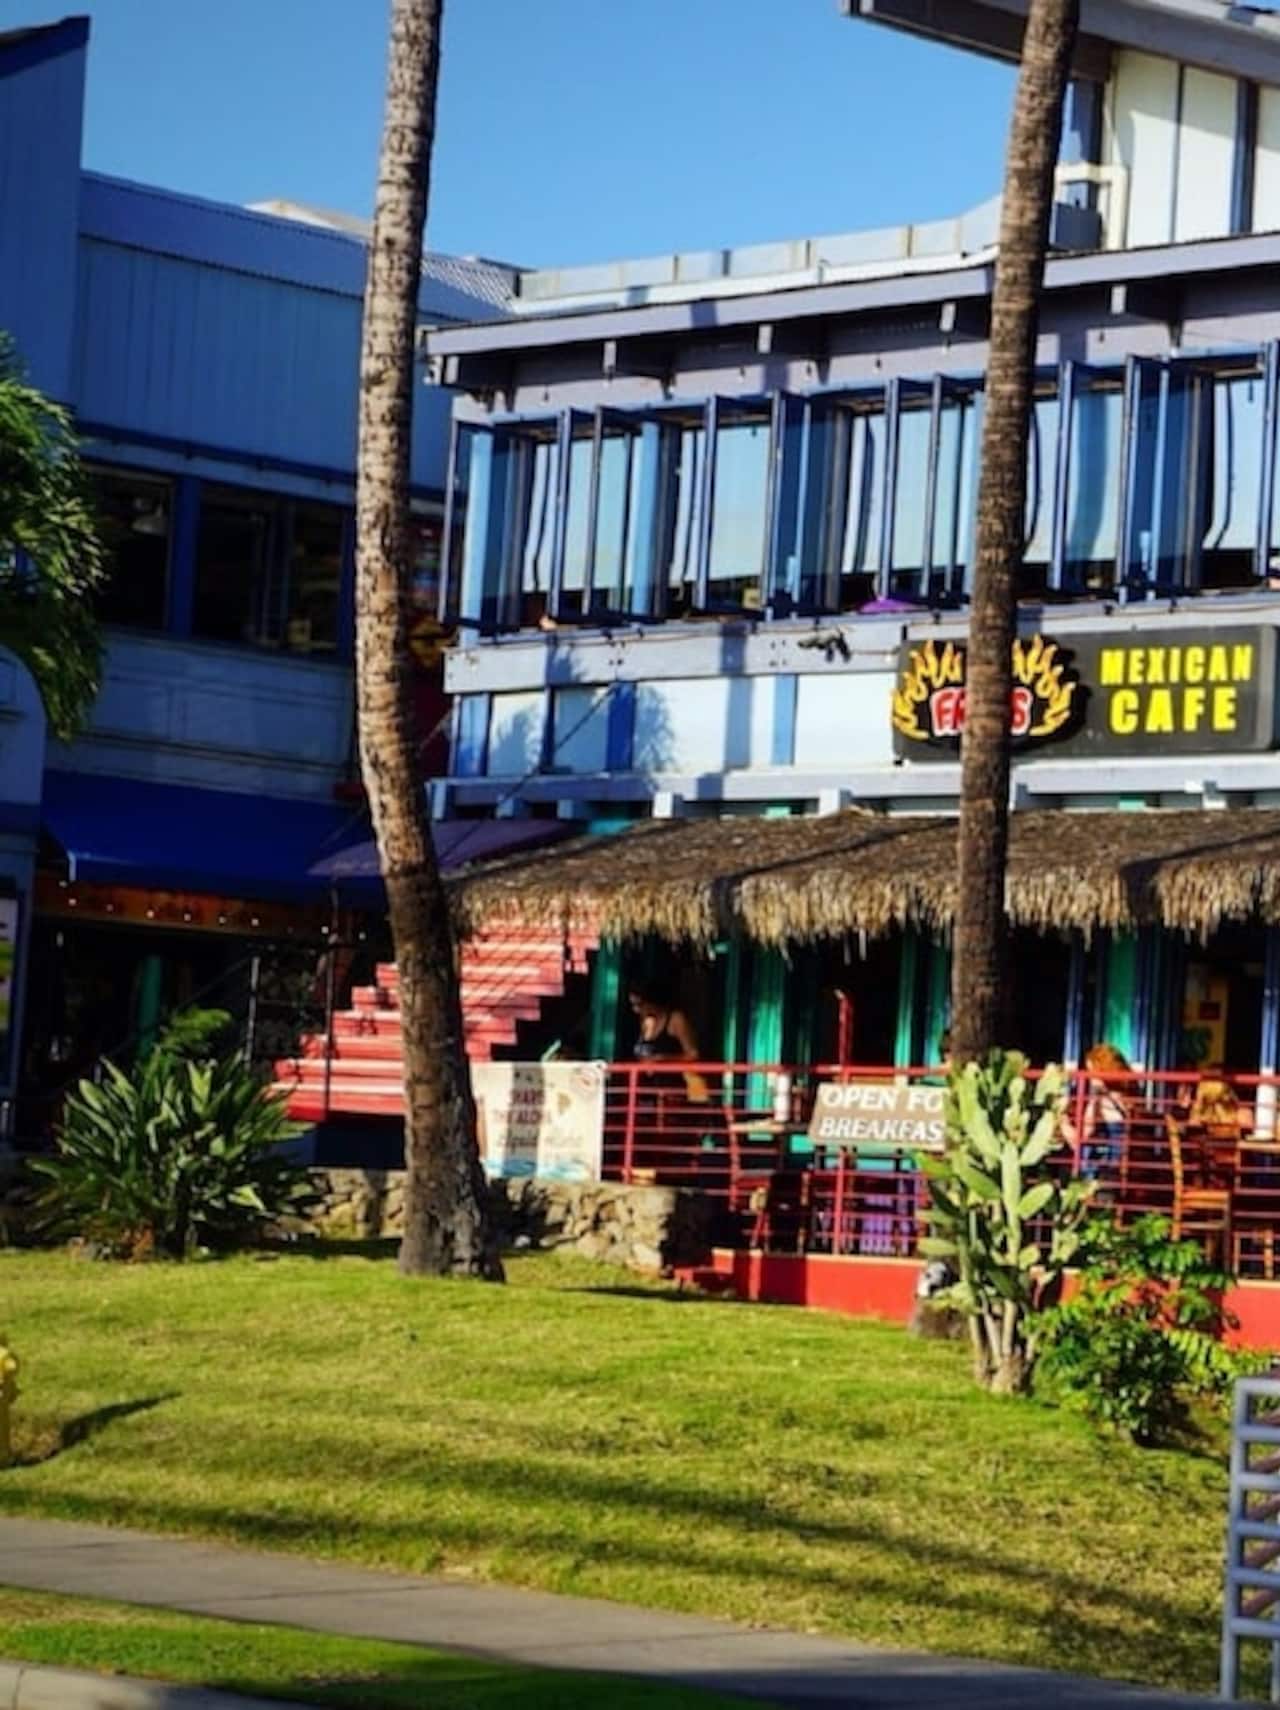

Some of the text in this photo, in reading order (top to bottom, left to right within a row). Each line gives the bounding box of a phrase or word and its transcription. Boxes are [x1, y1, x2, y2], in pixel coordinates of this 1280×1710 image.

[1100, 644, 1253, 686] MEXICAN
[1109, 686, 1238, 735] CAFE
[823, 1085, 945, 1113] OPEN FO
[820, 1116, 945, 1143] BREAKFAS
